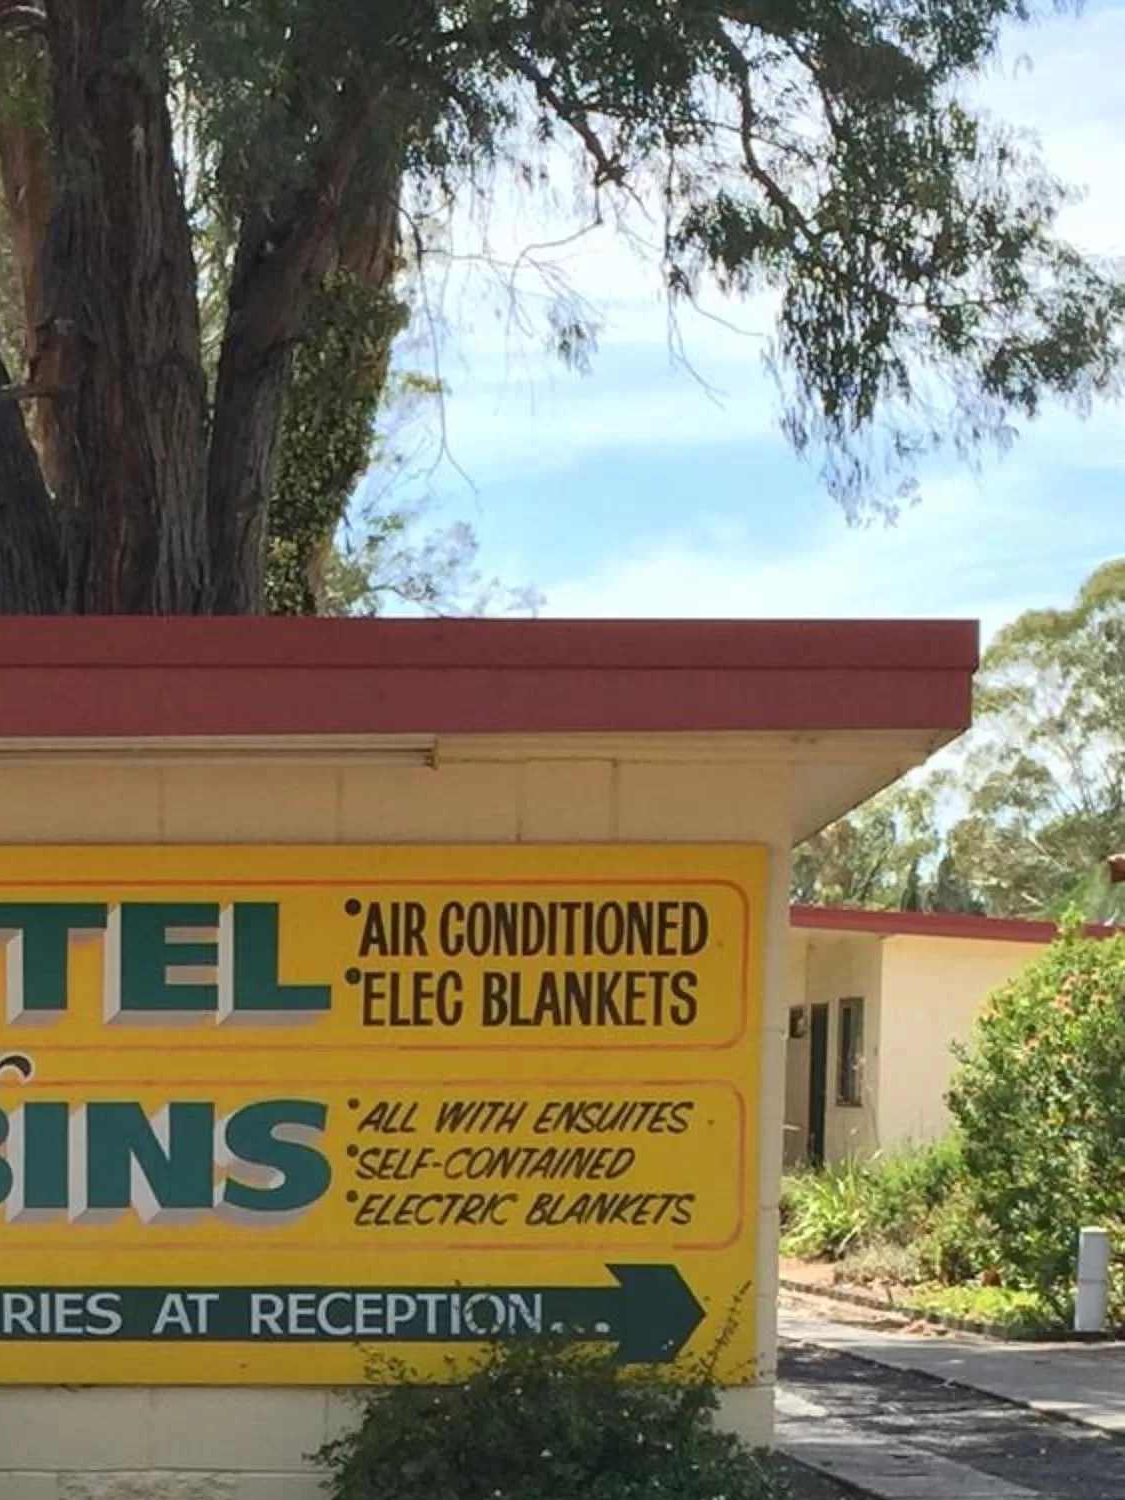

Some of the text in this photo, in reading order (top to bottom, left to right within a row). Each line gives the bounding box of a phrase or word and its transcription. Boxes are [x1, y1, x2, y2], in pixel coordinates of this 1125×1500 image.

[359, 900, 709, 957] AIR CONDITIONED
[362, 970, 698, 1027] ELEC BLANKETS
[357, 1101, 695, 1134] ALL WITH ENSUITES
[355, 1147, 636, 1181] SELF-CONTAINED
[353, 1193, 696, 1227] ELECTRIC BLANKETS
[153, 1292, 219, 1334] AT
